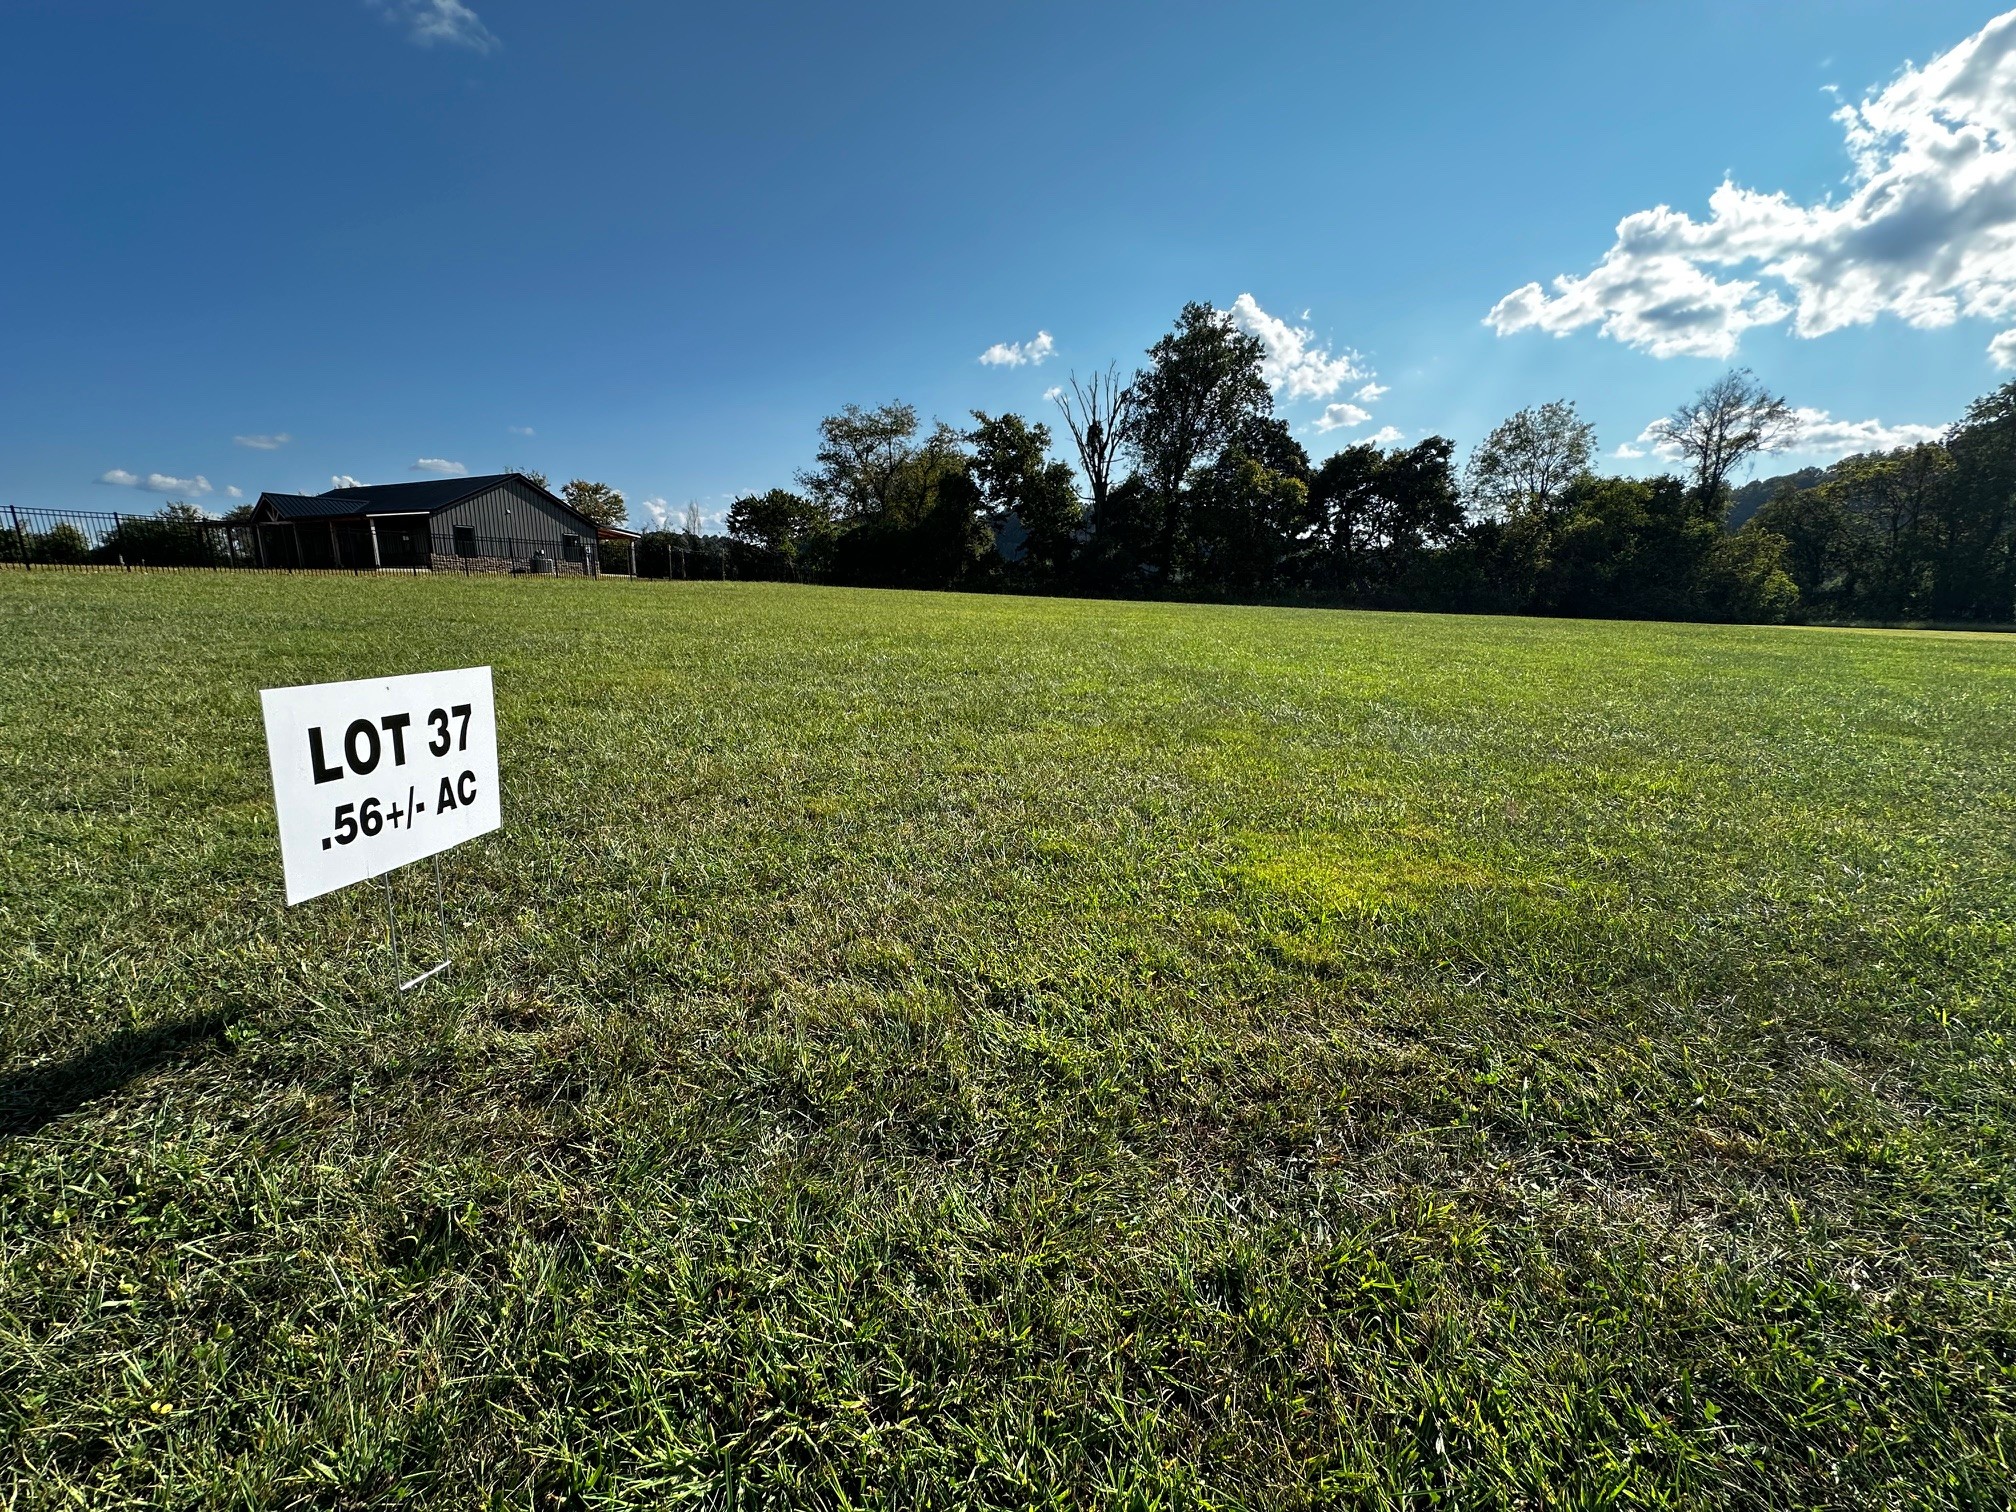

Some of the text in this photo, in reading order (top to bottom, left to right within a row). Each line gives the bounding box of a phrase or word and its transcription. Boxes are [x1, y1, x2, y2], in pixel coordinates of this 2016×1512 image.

[308, 703, 472, 785] LOT 37
[321, 769, 477, 851] .56+/- AC
